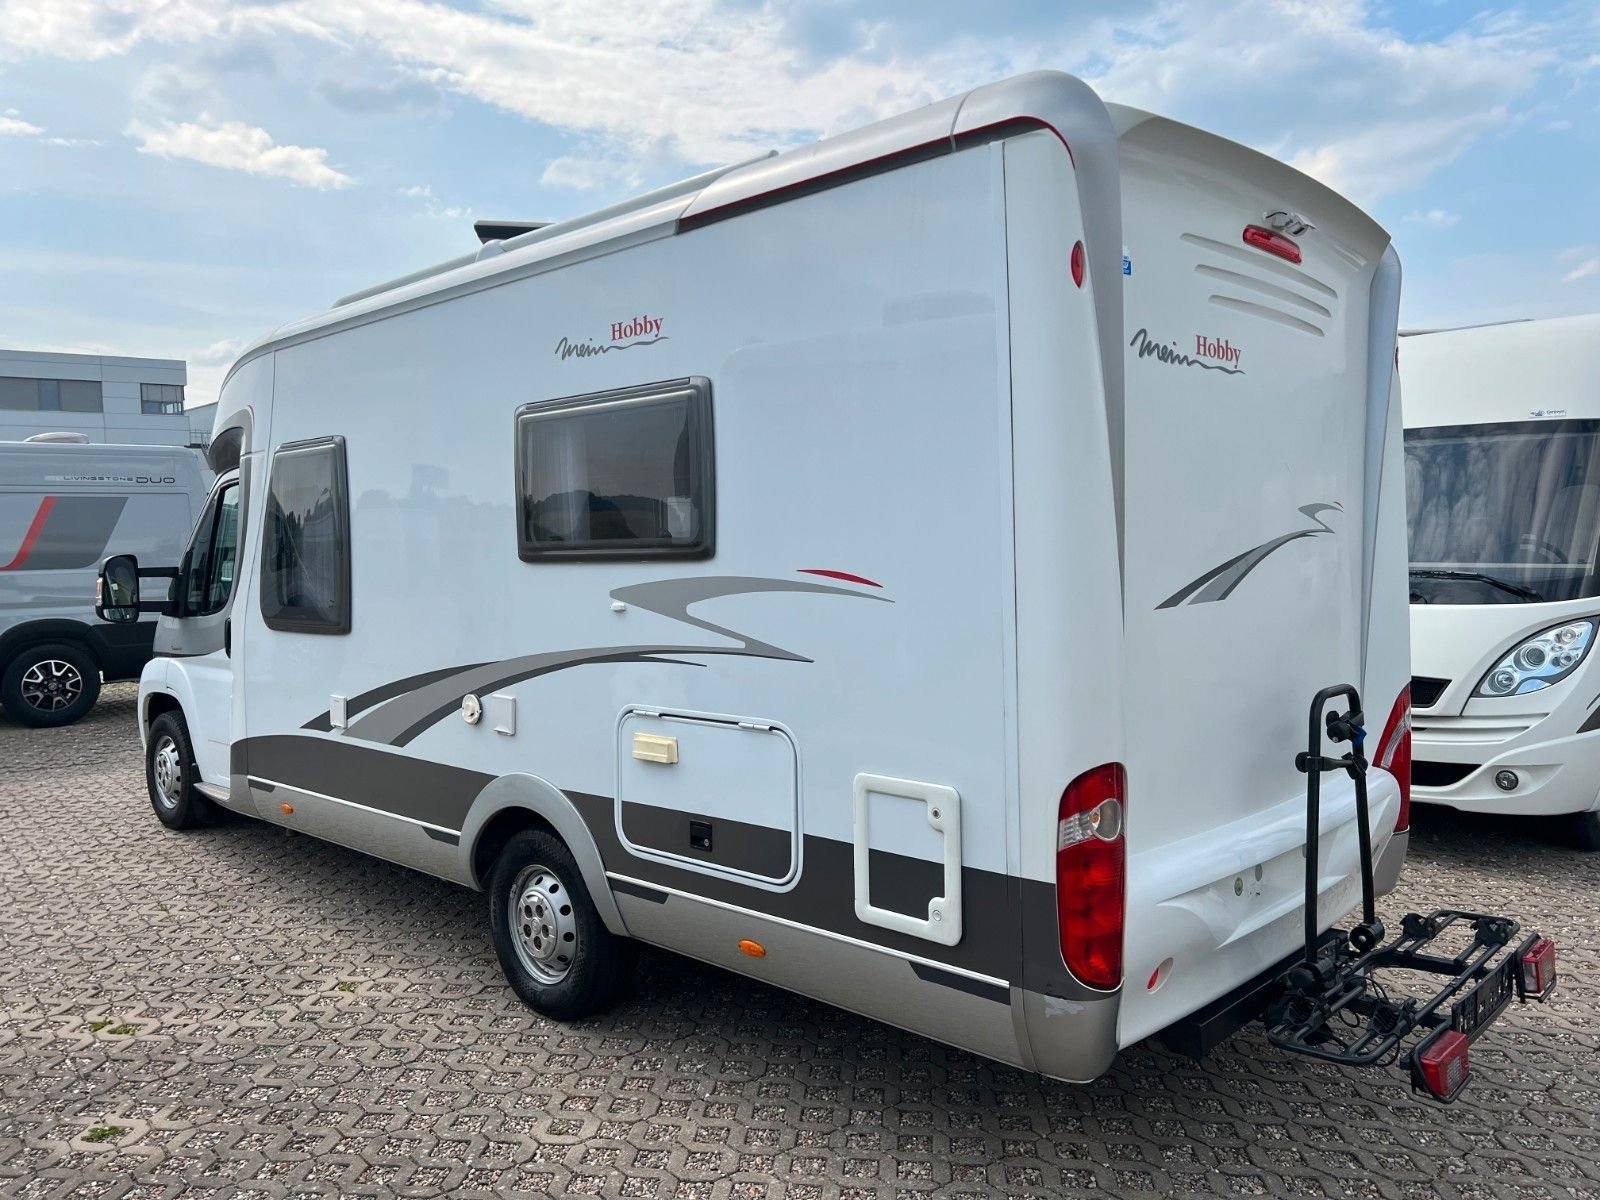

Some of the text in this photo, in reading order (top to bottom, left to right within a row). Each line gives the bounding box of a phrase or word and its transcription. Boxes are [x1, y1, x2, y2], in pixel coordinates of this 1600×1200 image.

[610, 314, 665, 341] Hobby
[1195, 334, 1242, 370] Hobby
[135, 476, 176, 484] DUO
